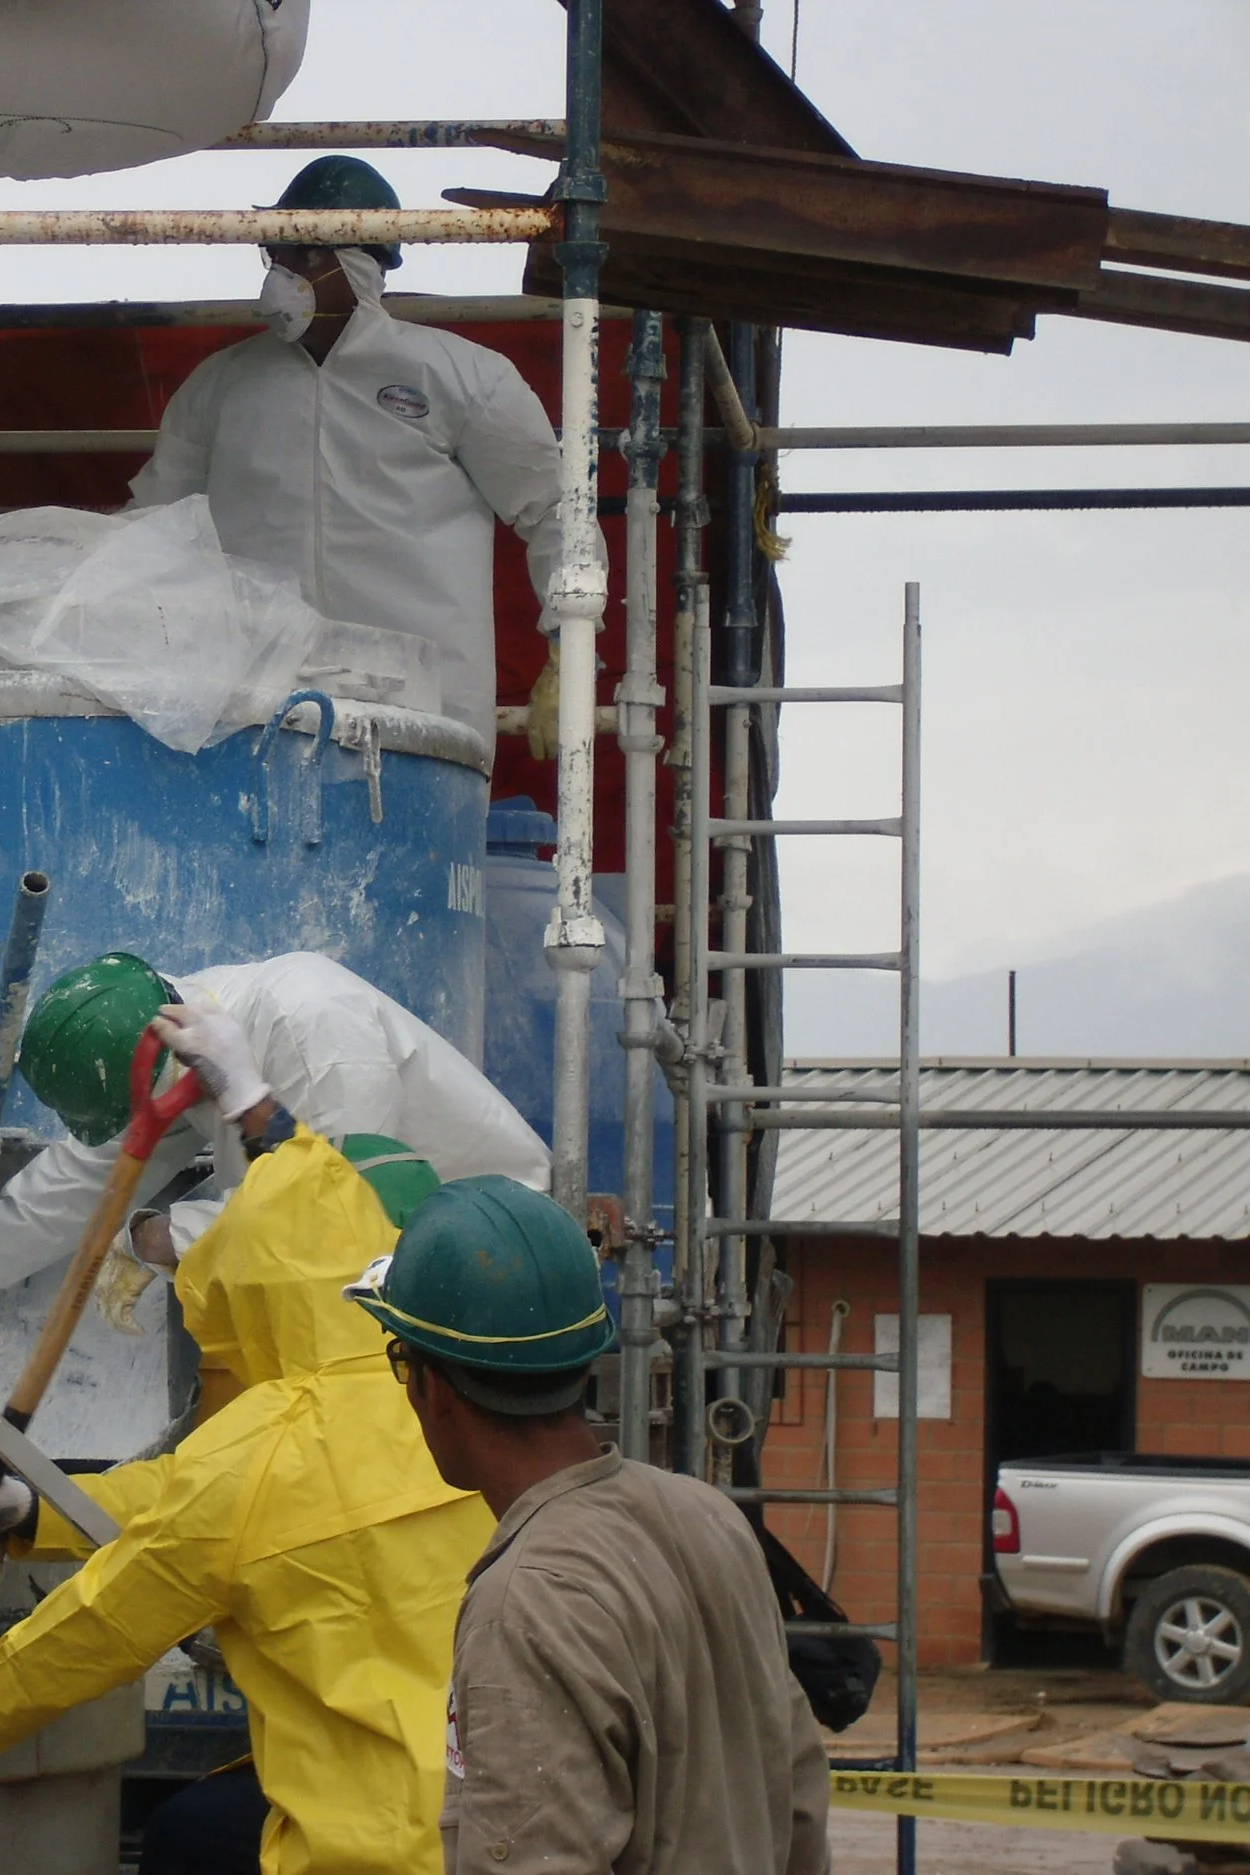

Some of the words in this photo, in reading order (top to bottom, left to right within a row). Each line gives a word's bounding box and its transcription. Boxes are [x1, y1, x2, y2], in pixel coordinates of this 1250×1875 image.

[1163, 1325, 1250, 1343] MAN
[1167, 1350, 1223, 1360] OFICINA
[1226, 1350, 1243, 1360] DE
[1181, 1363, 1229, 1372] CAMPO
